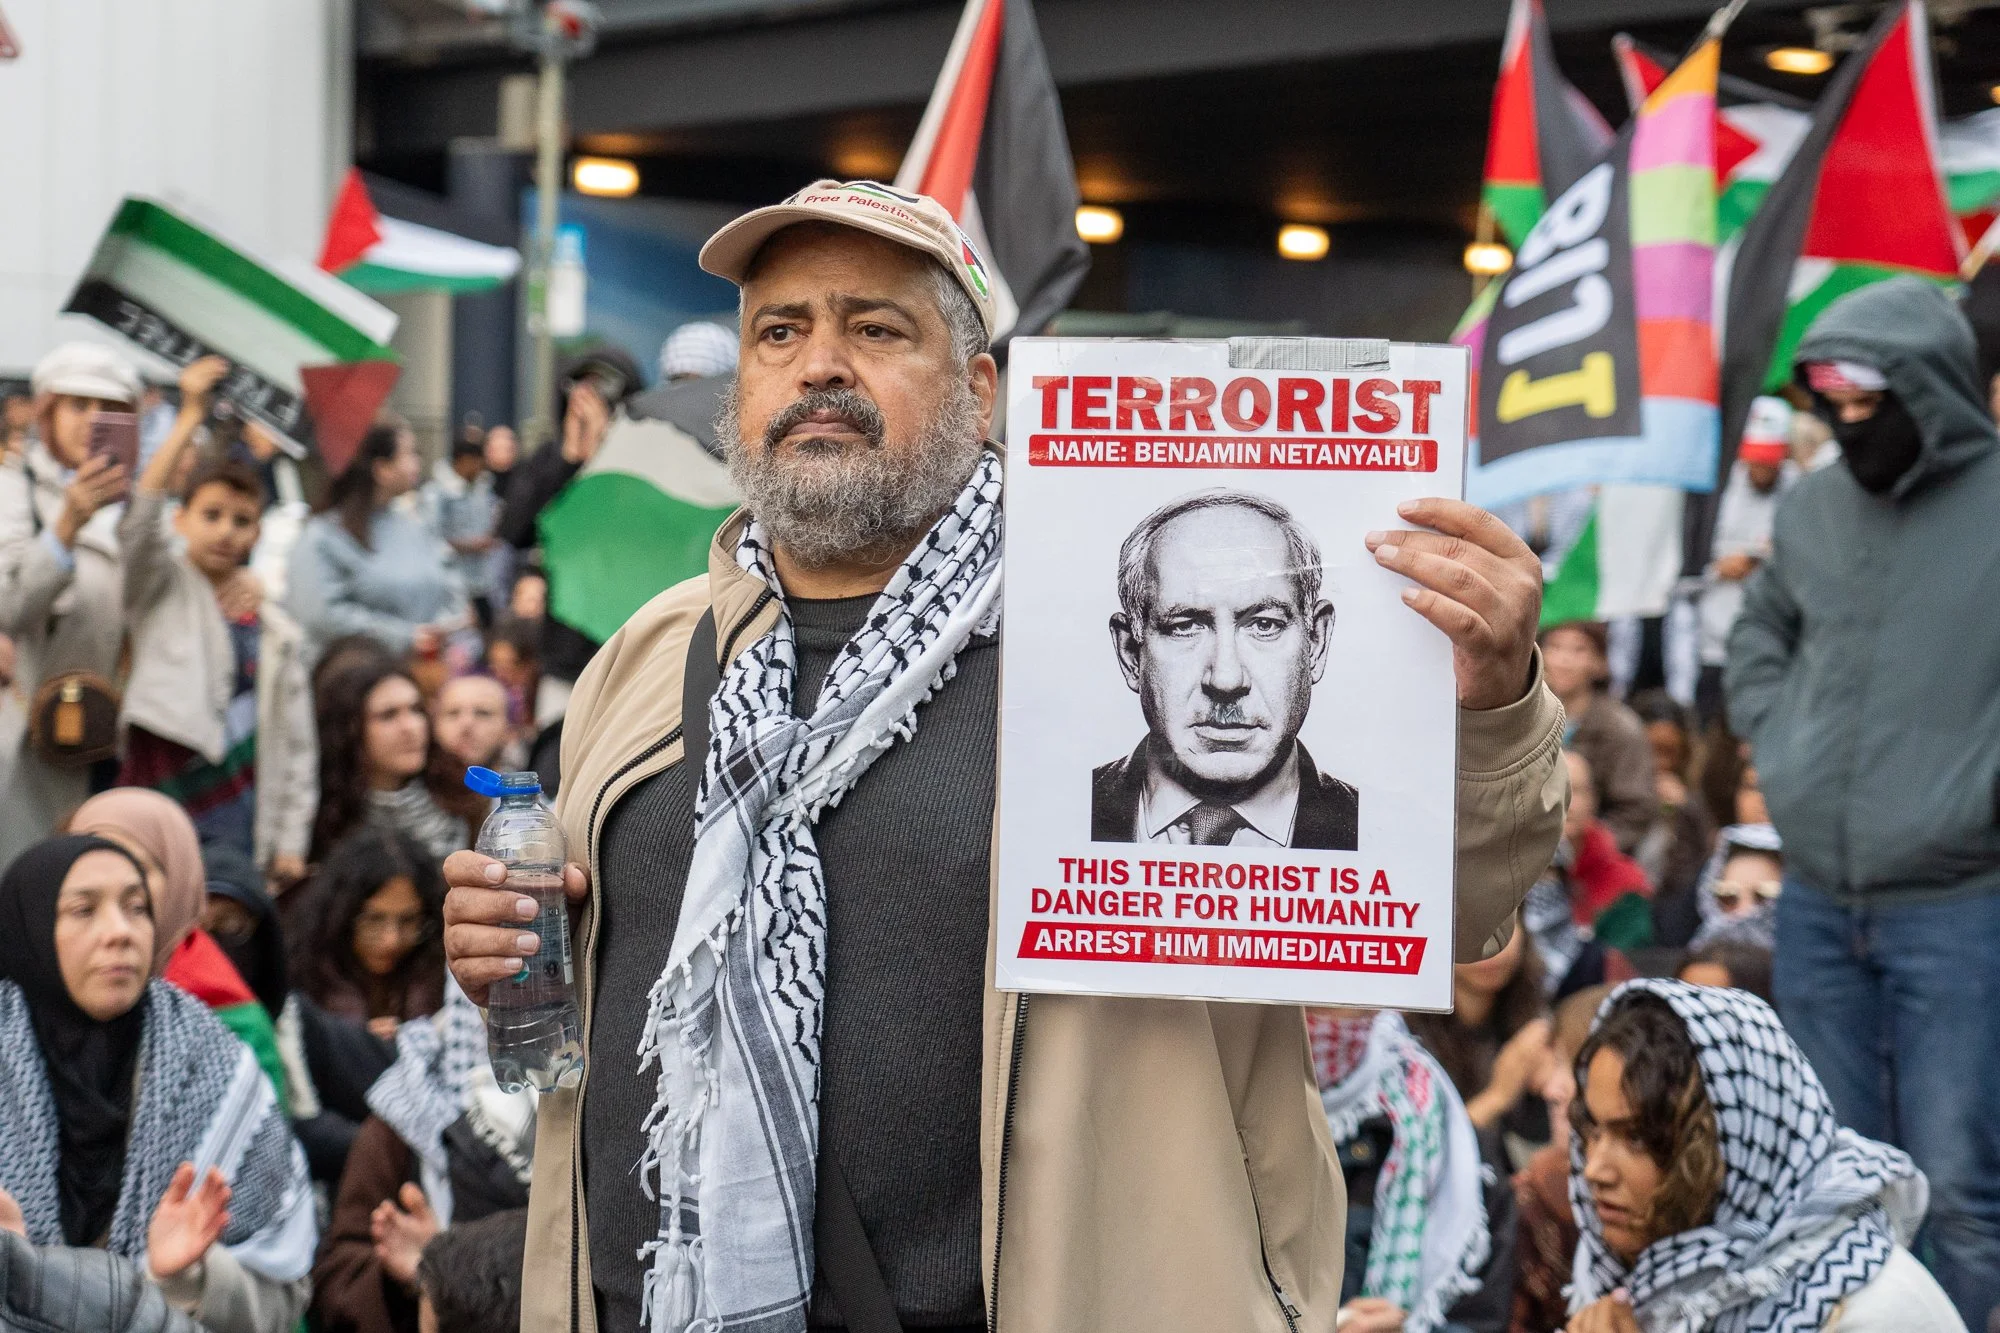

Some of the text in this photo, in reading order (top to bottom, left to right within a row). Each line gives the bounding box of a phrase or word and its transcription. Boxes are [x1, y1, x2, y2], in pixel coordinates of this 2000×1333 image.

[804, 195, 841, 204] Free
[1032, 376, 1441, 434] TERRORIST
[1048, 440, 1420, 466] NAME: BENJAMIN NETANYAHU
[1058, 857, 1392, 896] THIS TERRORIST IS A
[1031, 888, 1421, 928] DANGER FOR HUMANITY
[1034, 928, 1415, 966] ARREST HIM IMMEDIATELY
